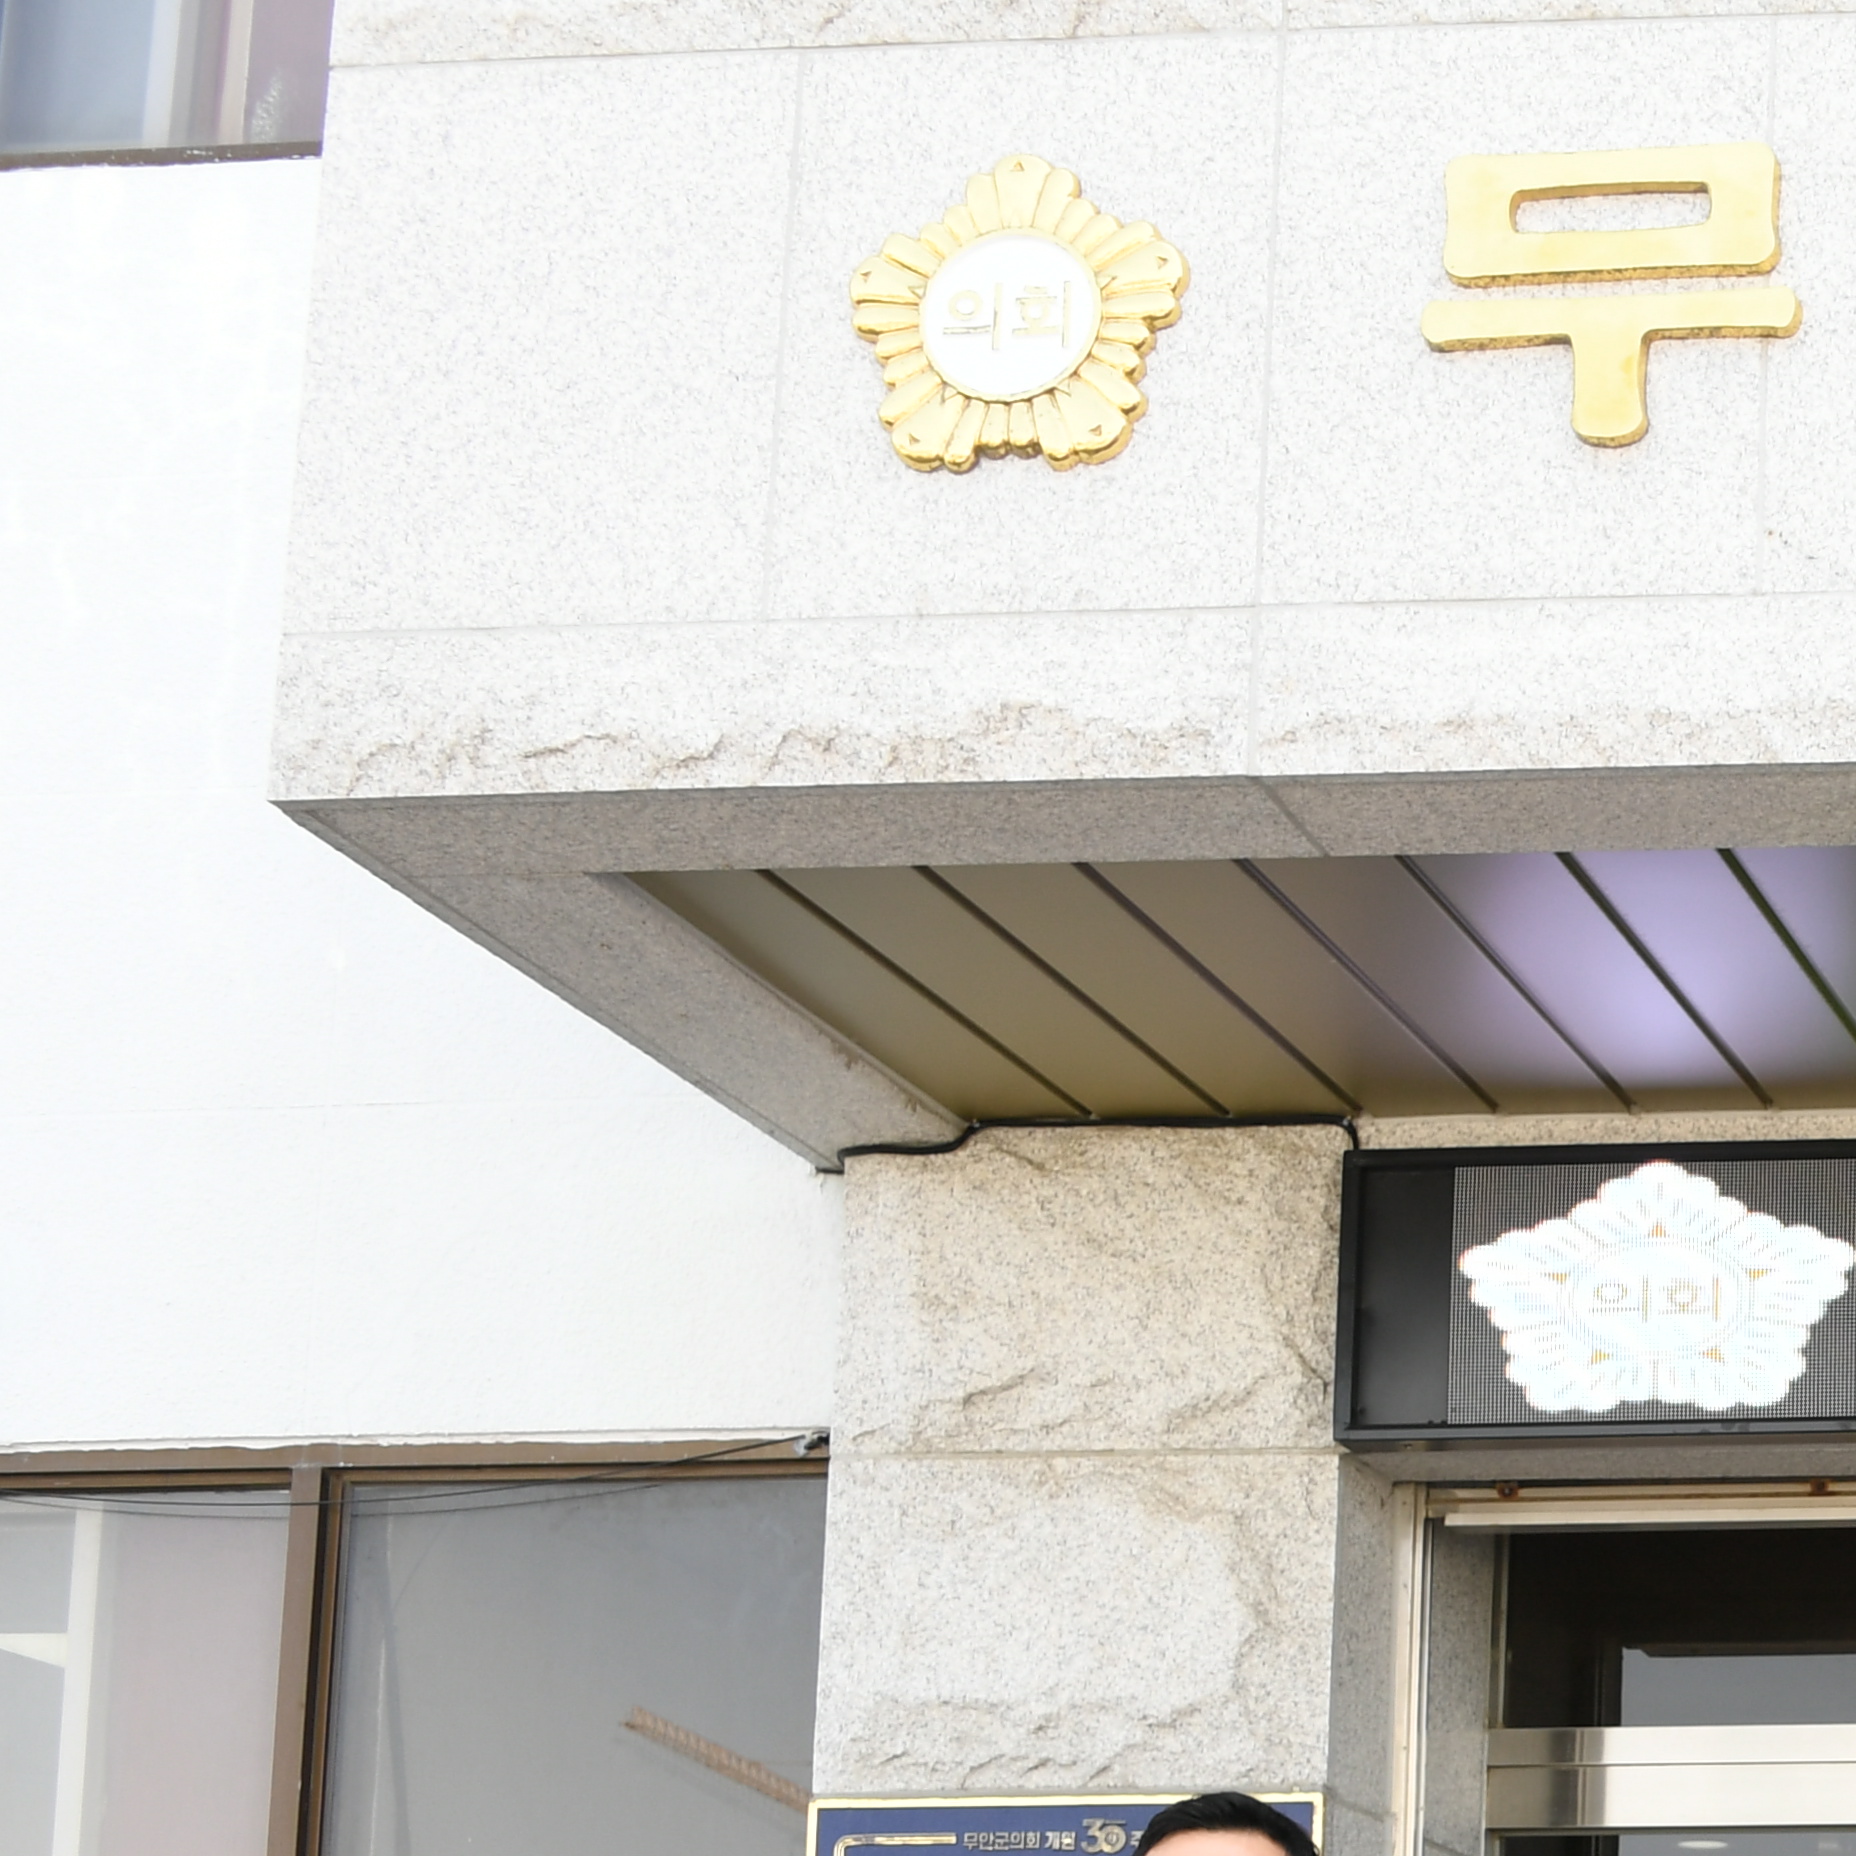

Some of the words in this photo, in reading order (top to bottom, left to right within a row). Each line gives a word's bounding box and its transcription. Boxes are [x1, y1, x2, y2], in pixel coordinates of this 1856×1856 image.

[943, 280, 1071, 350] 의회
[962, 1831, 1041, 1851] 무안군의회
[1044, 1831, 1077, 1850] 개원
